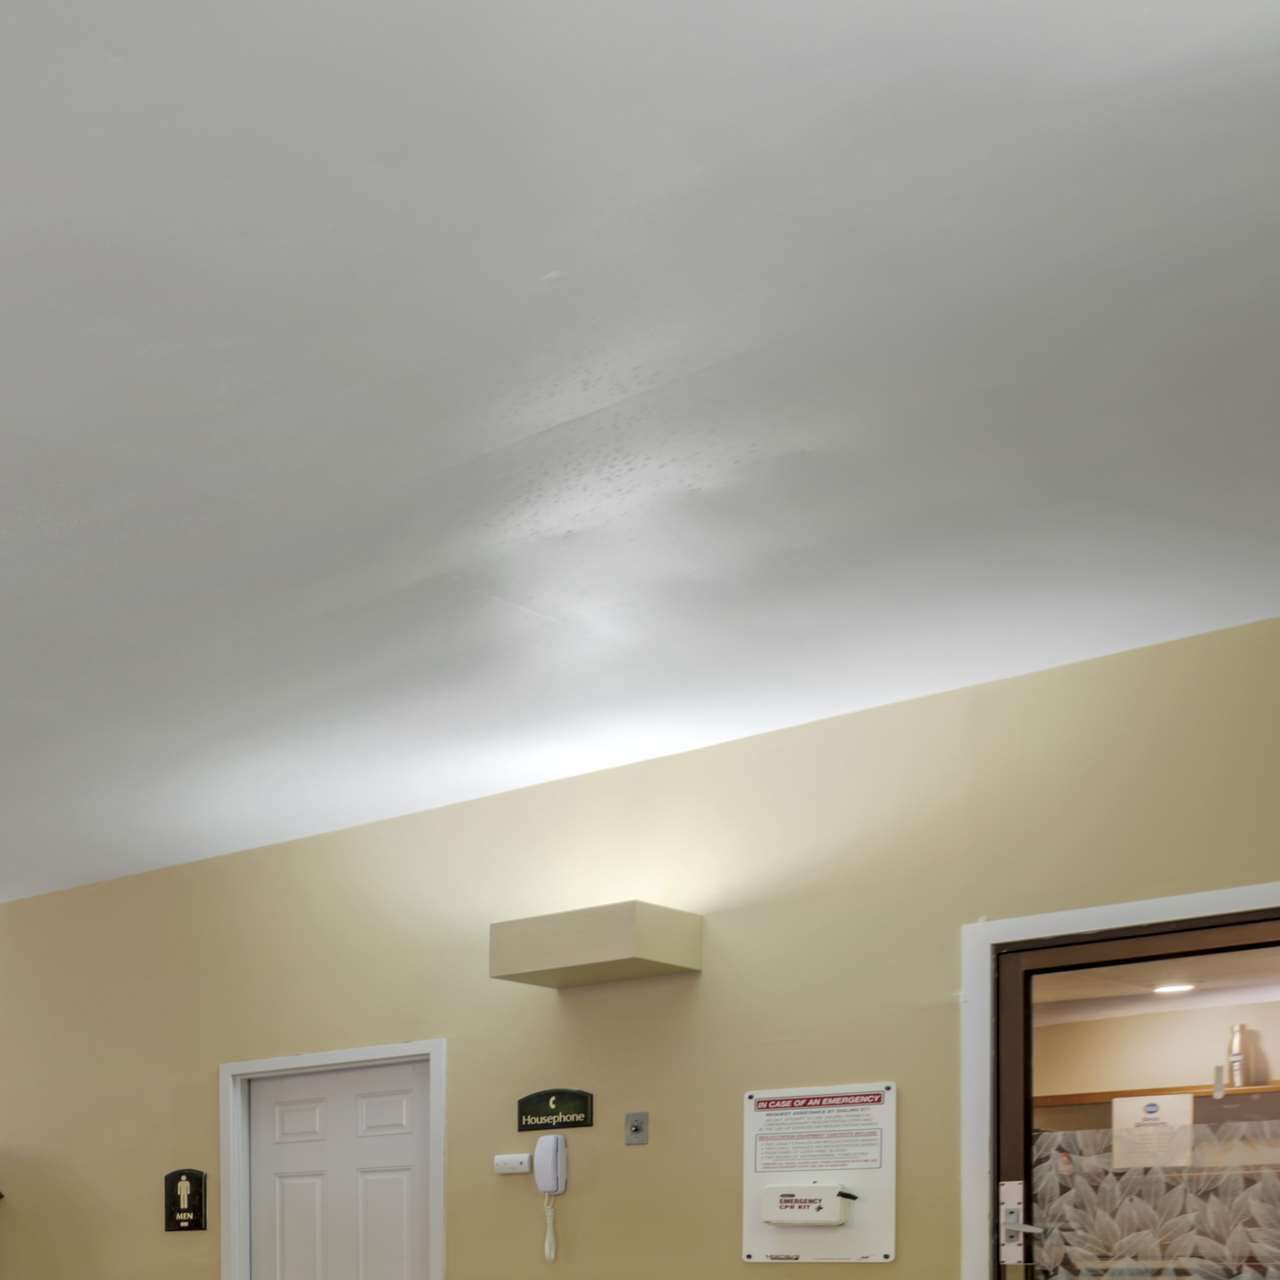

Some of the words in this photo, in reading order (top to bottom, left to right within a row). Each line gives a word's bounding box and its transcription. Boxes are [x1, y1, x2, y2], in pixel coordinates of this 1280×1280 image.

[768, 1100, 793, 1108] CASE
[793, 1099, 807, 1107] OF
[807, 1098, 821, 1106] AN
[821, 1095, 881, 1105] EMERGENCY
[522, 1112, 585, 1125] Housephone
[176, 1212, 194, 1220] MEN
